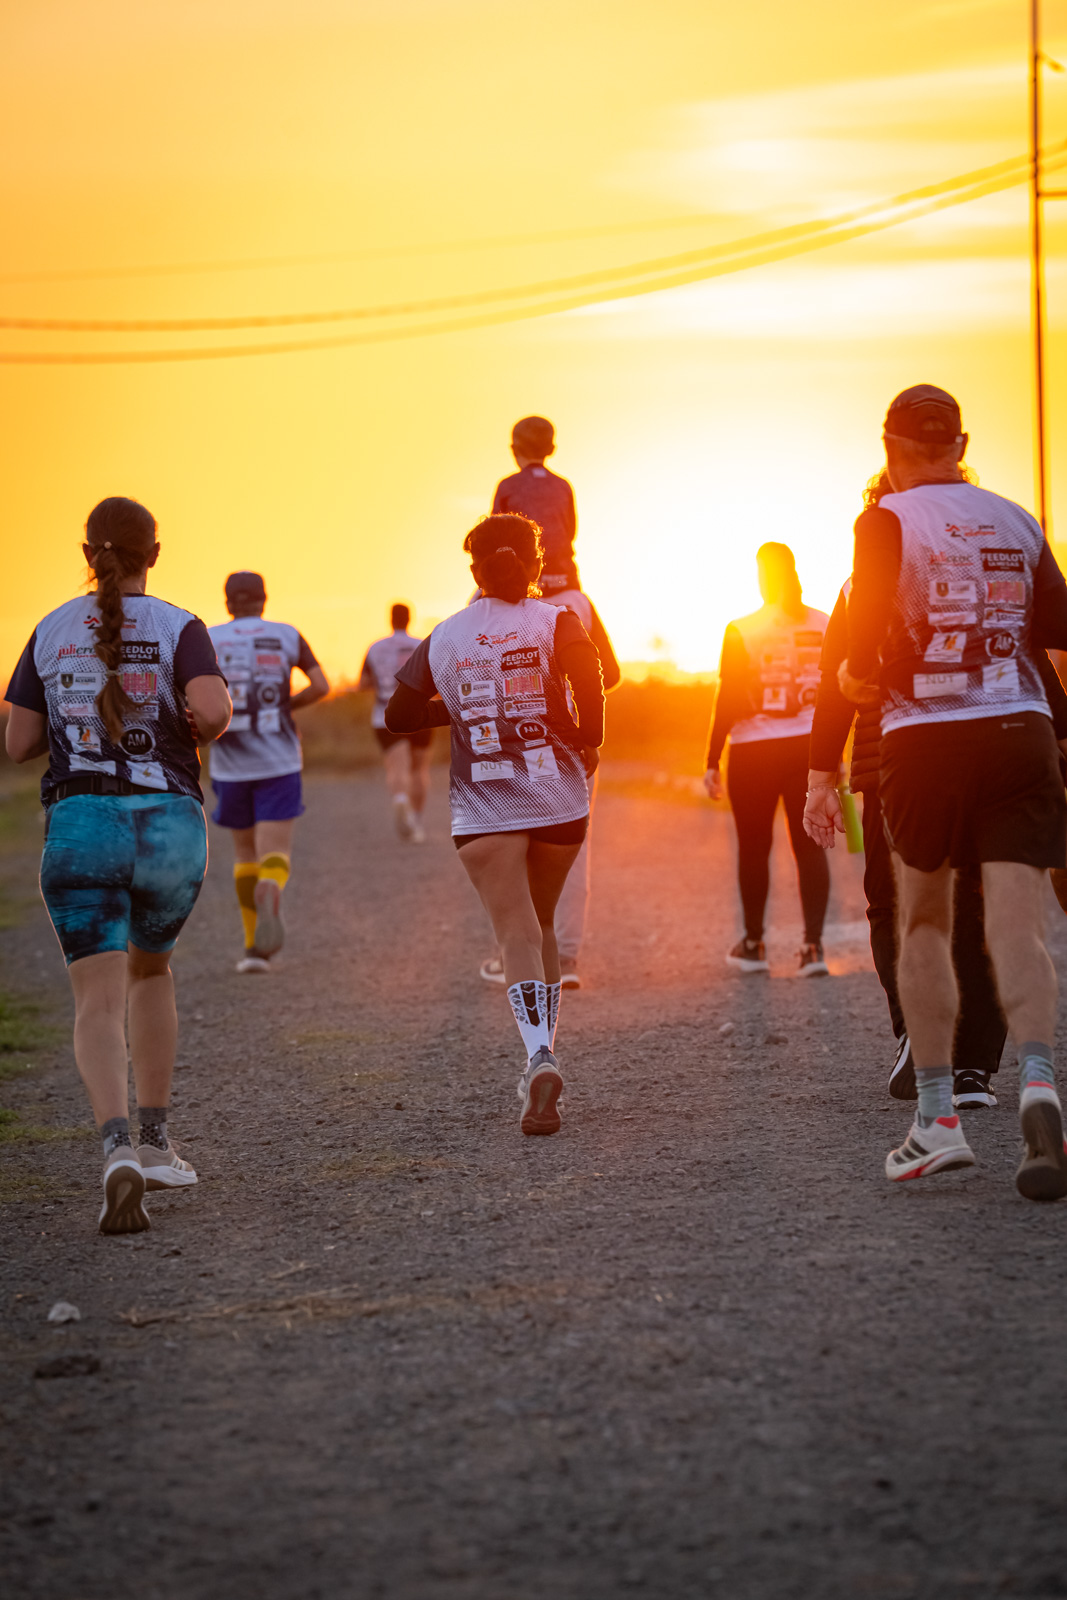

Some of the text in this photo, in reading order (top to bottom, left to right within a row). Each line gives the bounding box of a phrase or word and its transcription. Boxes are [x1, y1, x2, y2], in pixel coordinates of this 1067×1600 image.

[982, 553, 1025, 562] FEEDLOT
[120, 645, 158, 655] EEDLOT
[502, 651, 538, 663] FEEDLOT
[127, 733, 146, 746] AM
[480, 762, 503, 771] NUT
